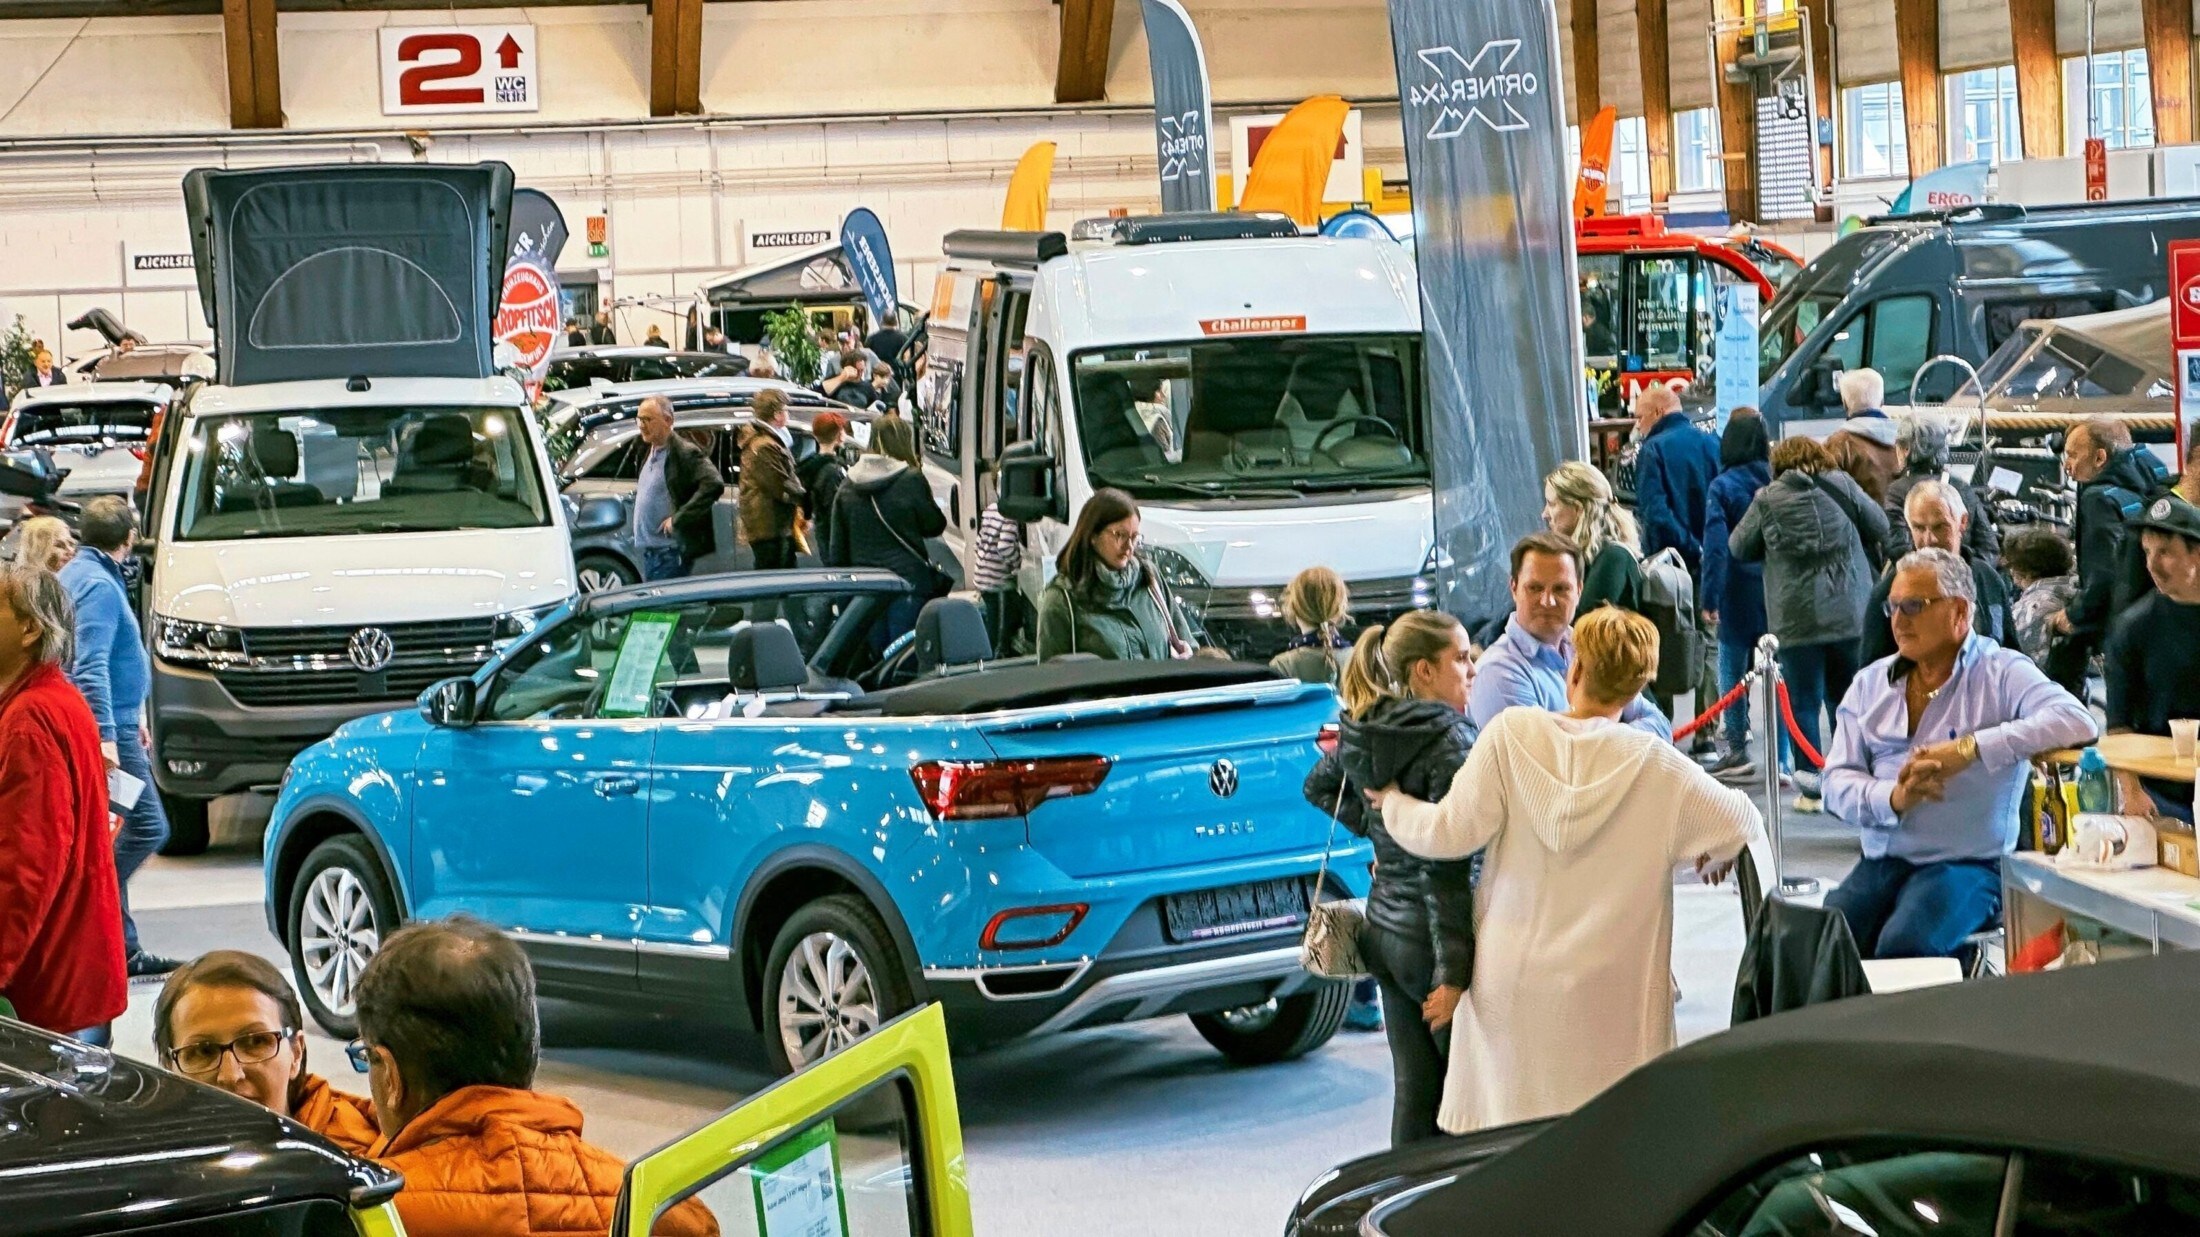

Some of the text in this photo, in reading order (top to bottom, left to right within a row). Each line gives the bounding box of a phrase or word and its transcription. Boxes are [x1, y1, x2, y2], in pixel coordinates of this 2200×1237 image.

[398, 34, 484, 105] 2
[496, 77, 525, 89] WC
[1928, 192, 1972, 208] ERGO
[756, 232, 828, 246] AICHLSEDER
[1211, 318, 1297, 332] Challenger
